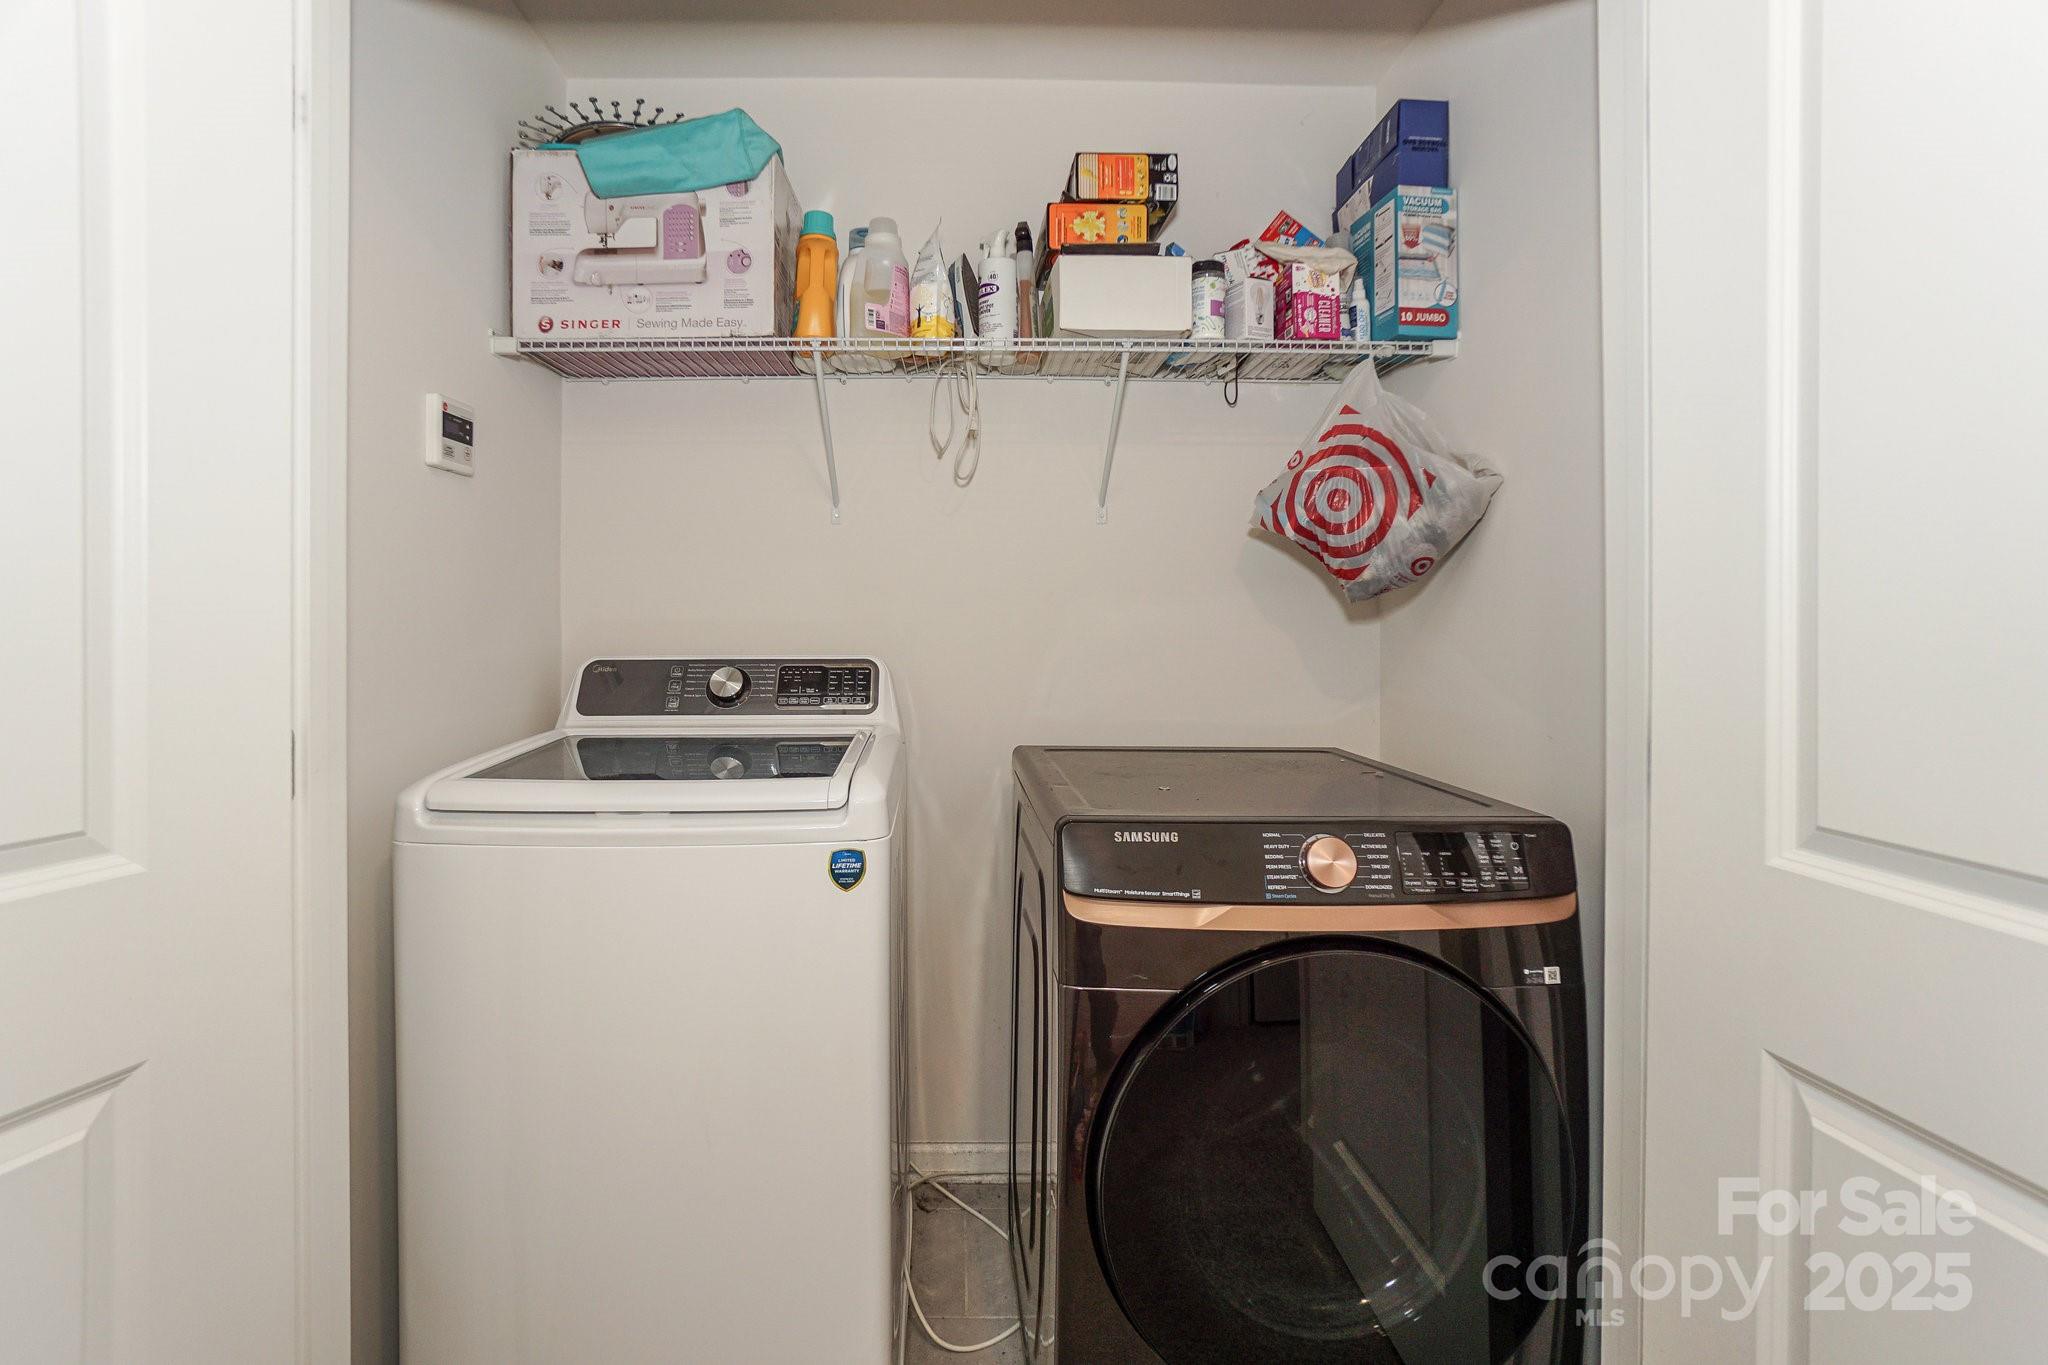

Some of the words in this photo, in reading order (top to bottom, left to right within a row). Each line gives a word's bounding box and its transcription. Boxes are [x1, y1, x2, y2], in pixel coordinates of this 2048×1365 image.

[1403, 196, 1442, 207] VACUUM
[1318, 299, 1332, 333] CLEANER
[1400, 311, 1413, 321] 10
[1415, 312, 1447, 323] JUMBO
[560, 319, 622, 329] SINGER
[636, 317, 678, 330] Sewing
[681, 317, 714, 328] Made
[1114, 831, 1179, 843] SAMSUNG
[1162, 891, 1191, 899] SmartThings
